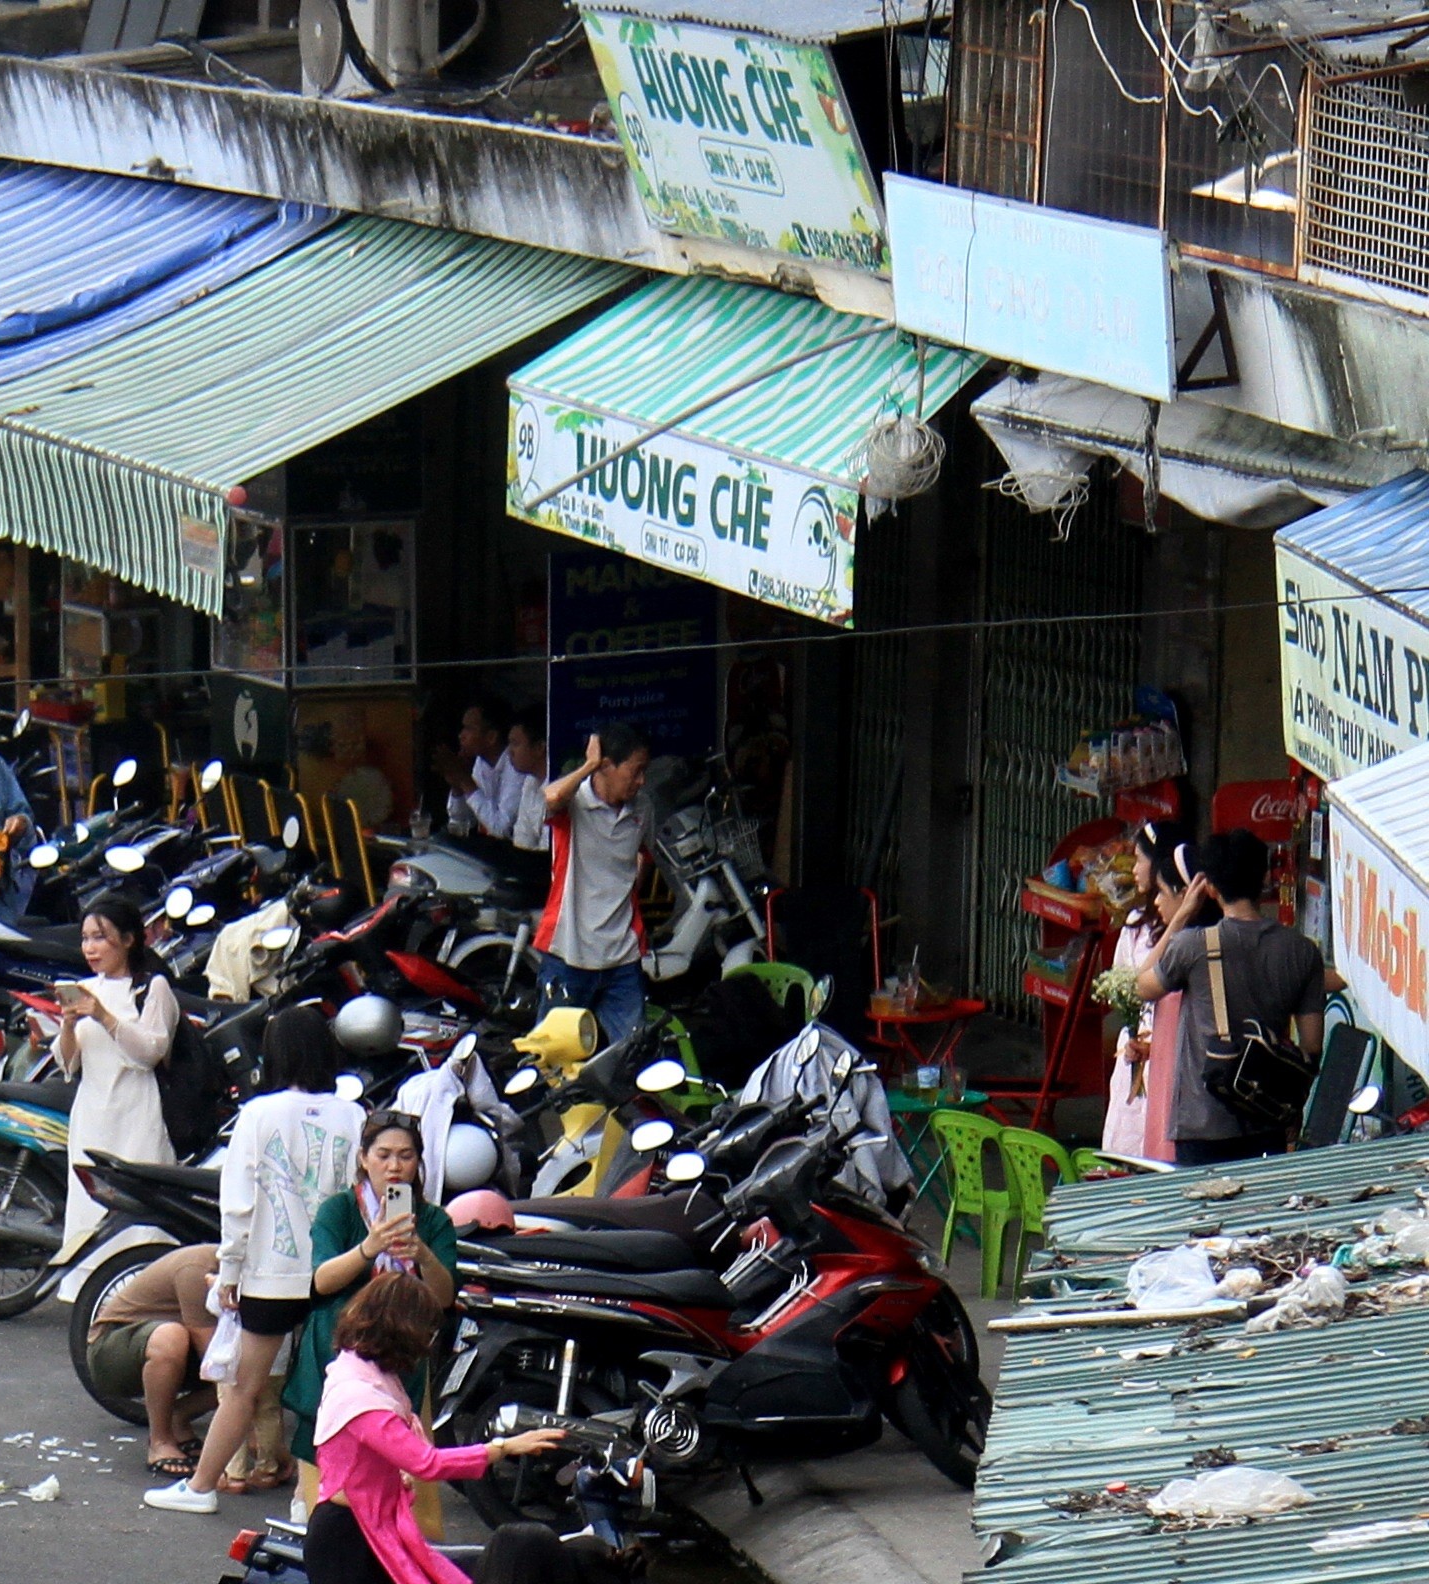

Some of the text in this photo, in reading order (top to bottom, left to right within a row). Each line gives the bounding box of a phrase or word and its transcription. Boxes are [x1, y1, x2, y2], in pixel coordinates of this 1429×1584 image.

[629, 45, 814, 148] HƯƠNG CHÈ
[625, 113, 651, 160] 9B
[518, 422, 535, 461] 9B
[576, 431, 773, 552] HƯƠNG CHÈ
[600, 690, 665, 710] Pure juice
[1332, 605, 1399, 727] NAM
